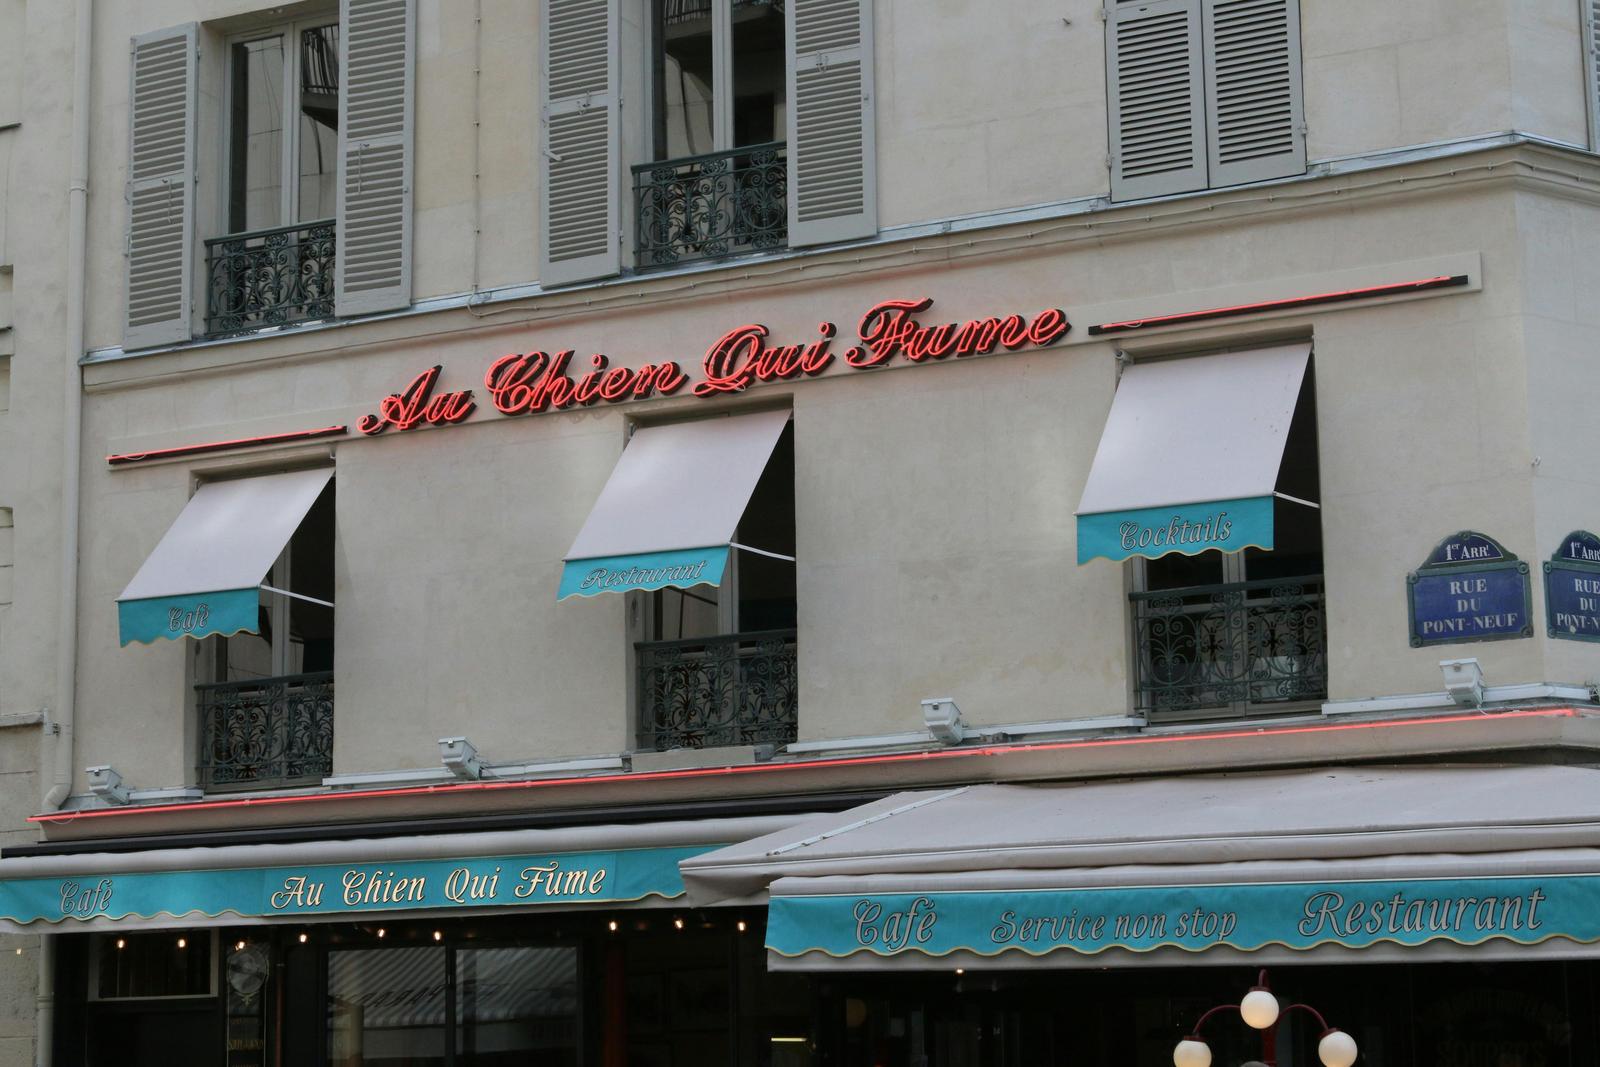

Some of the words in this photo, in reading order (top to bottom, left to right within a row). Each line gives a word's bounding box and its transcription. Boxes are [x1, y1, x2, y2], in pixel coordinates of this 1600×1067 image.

[357, 364, 476, 435] Au
[484, 349, 690, 417] Chien
[691, 322, 837, 398] Qui
[844, 297, 1073, 369] Fume
[1119, 511, 1232, 550] Cocktails
[580, 560, 707, 590] Restaurant
[1449, 578, 1488, 595] RUE
[1574, 577, 1600, 595] RUE
[168, 602, 209, 633] Café
[1457, 597, 1481, 613] DU
[1580, 597, 1597, 611] DU
[1423, 613, 1518, 634] PONT-NEUF
[59, 879, 113, 917] Café
[270, 875, 325, 910] Au
[341, 869, 426, 906] Chien
[444, 866, 502, 903] Qui
[514, 861, 607, 898] Fume
[852, 896, 938, 953] Café
[990, 908, 1105, 944] Service
[1113, 910, 1167, 938] non
[1174, 906, 1238, 943] stop
[1297, 887, 1546, 938] Restaurant
